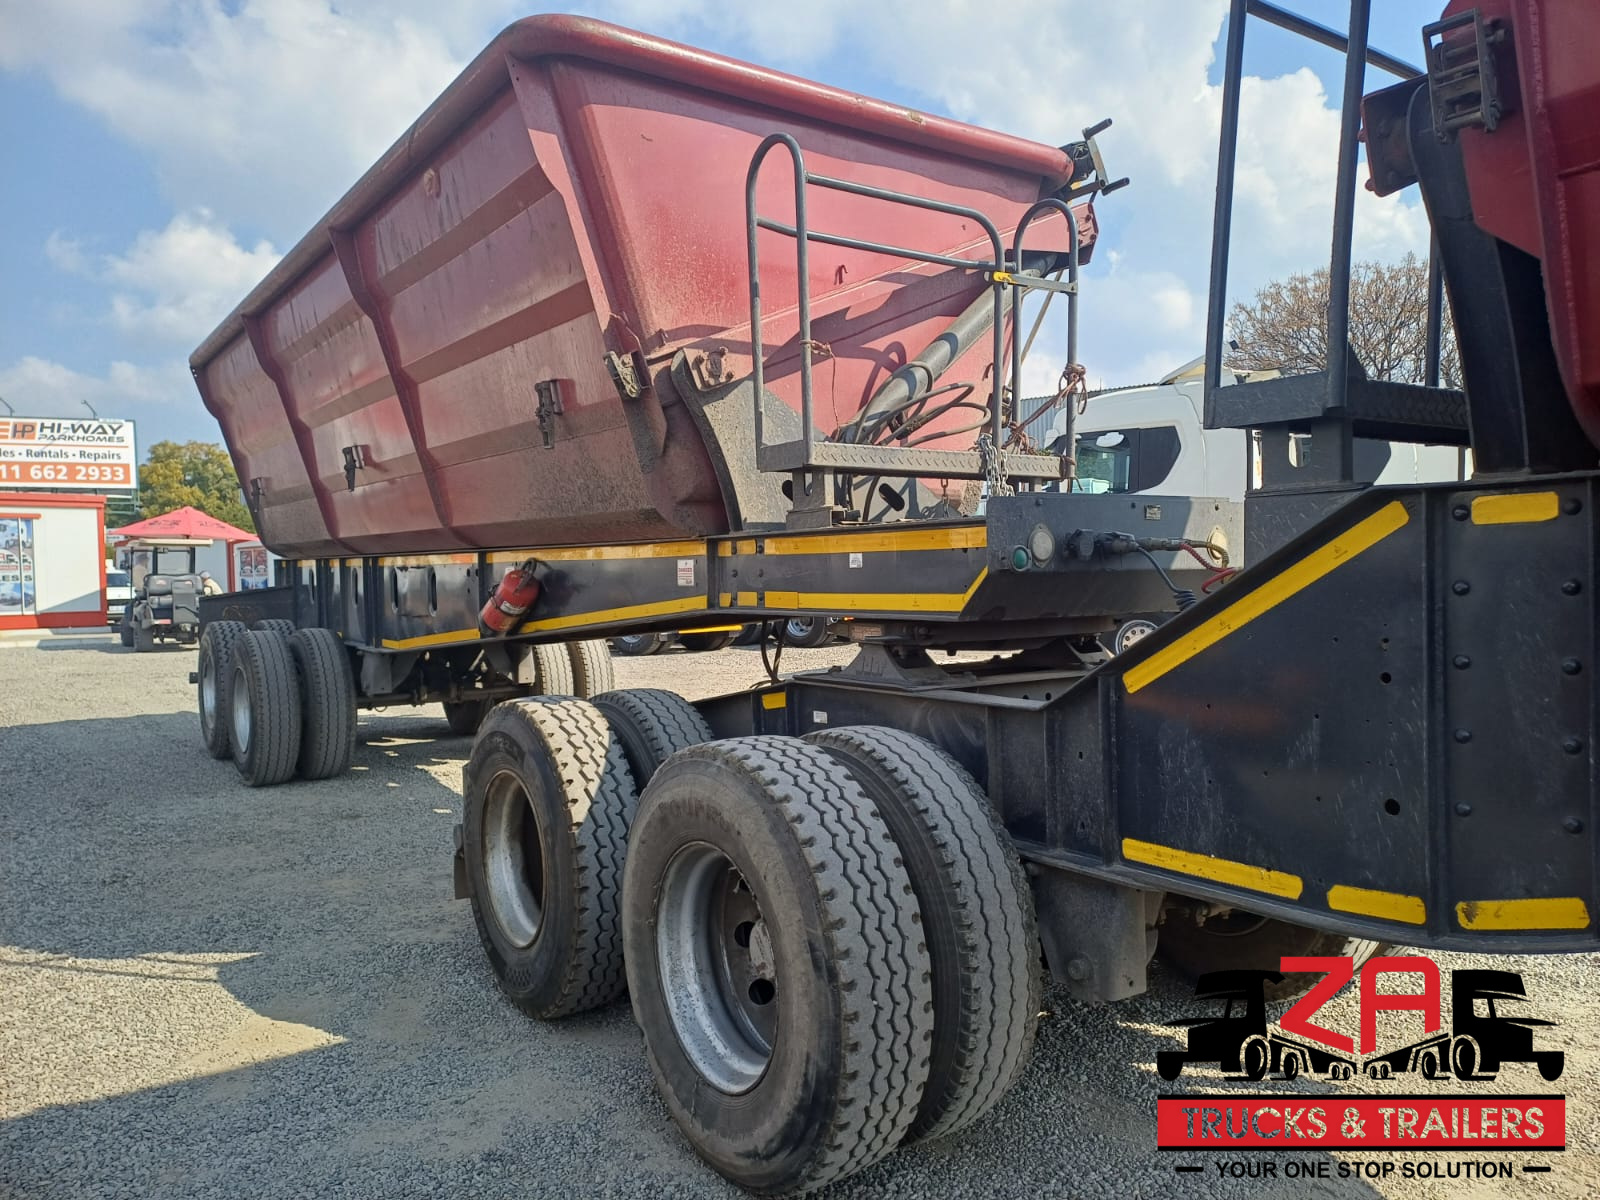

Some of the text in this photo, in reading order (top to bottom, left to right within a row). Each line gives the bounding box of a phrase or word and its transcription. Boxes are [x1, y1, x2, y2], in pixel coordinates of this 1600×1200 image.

[40, 422, 123, 435] HI-WAY
[38, 434, 125, 443] PARKHOMES
[26, 449, 69, 460] Rentals
[79, 450, 122, 461] Repairs
[30, 465, 68, 480] 662
[75, 466, 125, 481] 2933
